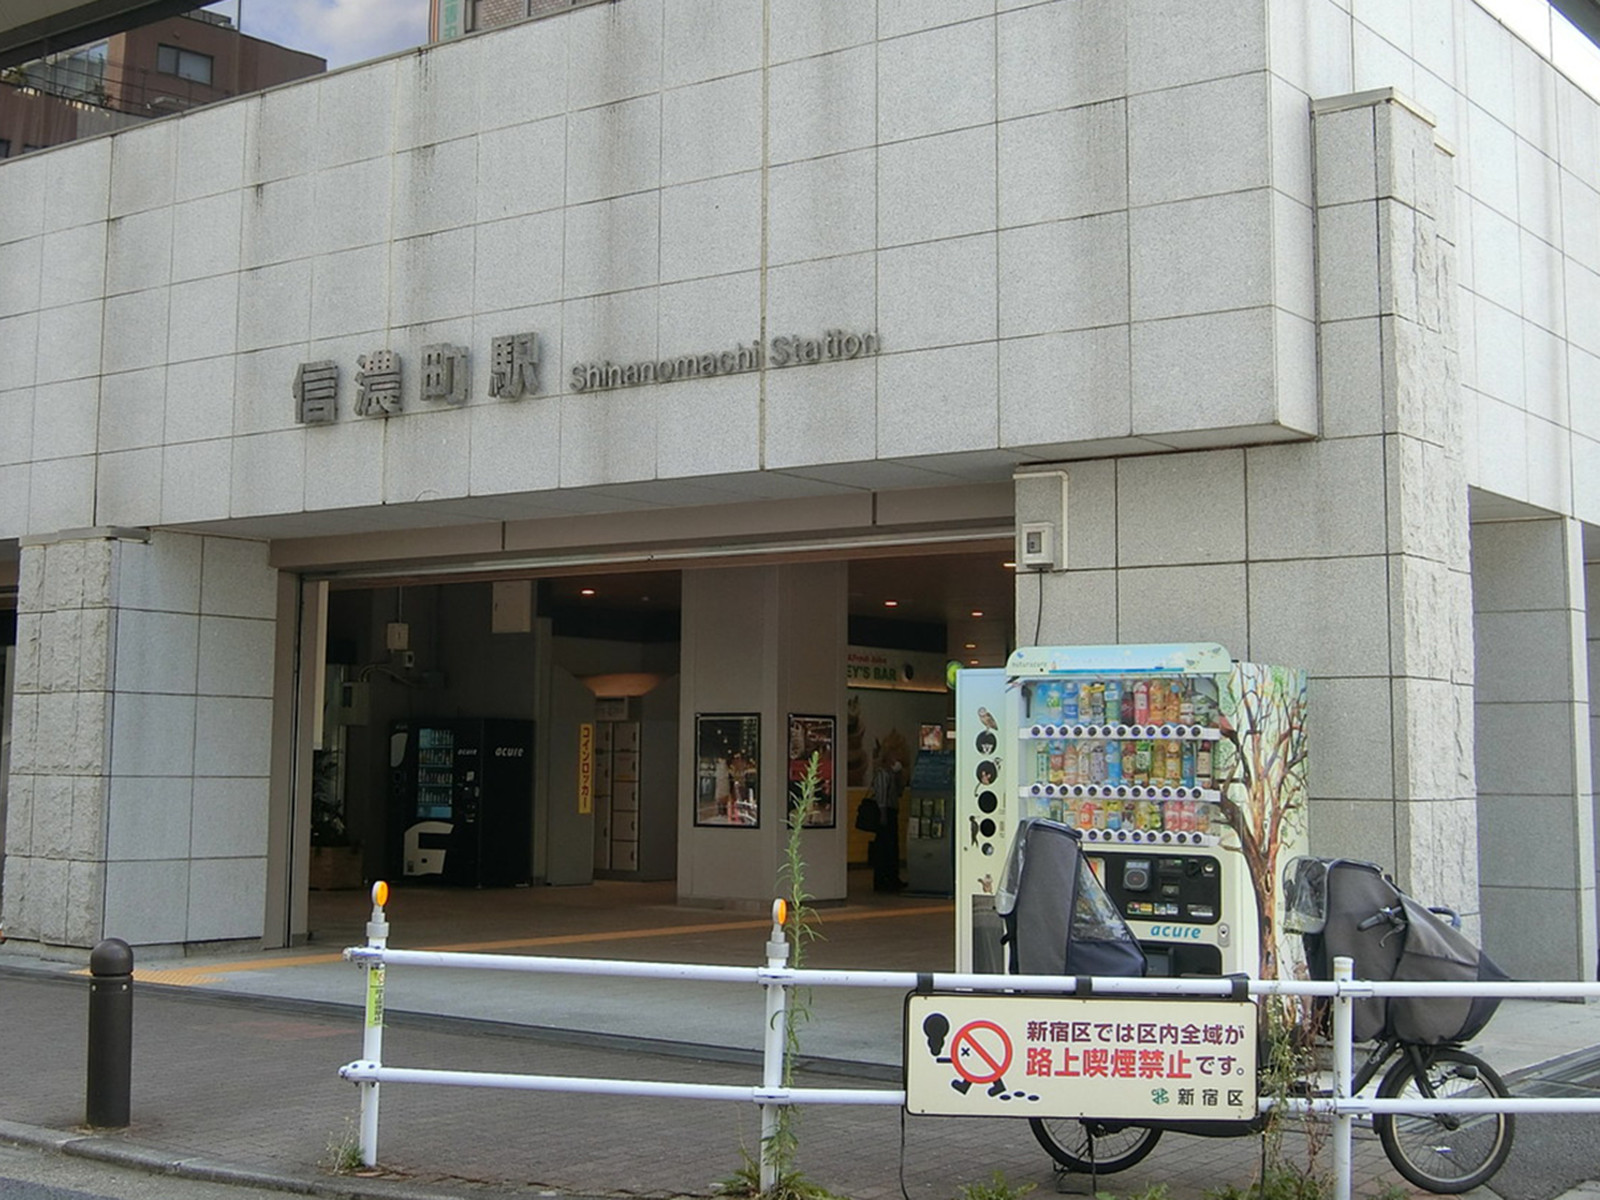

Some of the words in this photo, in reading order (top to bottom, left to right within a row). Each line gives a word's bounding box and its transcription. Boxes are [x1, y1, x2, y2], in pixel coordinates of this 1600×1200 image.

[569, 340, 760, 392] Shinanomachi
[769, 329, 881, 365] Station
[292, 332, 541, 424] 信濃町駅
[874, 667, 897, 681] BAR
[495, 747, 525, 757] acure
[581, 727, 590, 809] コインロッカー
[1150, 924, 1202, 939] acure
[1026, 1021, 1245, 1045] 新宿区では区内全域が
[1026, 1047, 1245, 1079] 路上喫煙禁止です。
[1177, 1088, 1243, 1106] 新宿区
